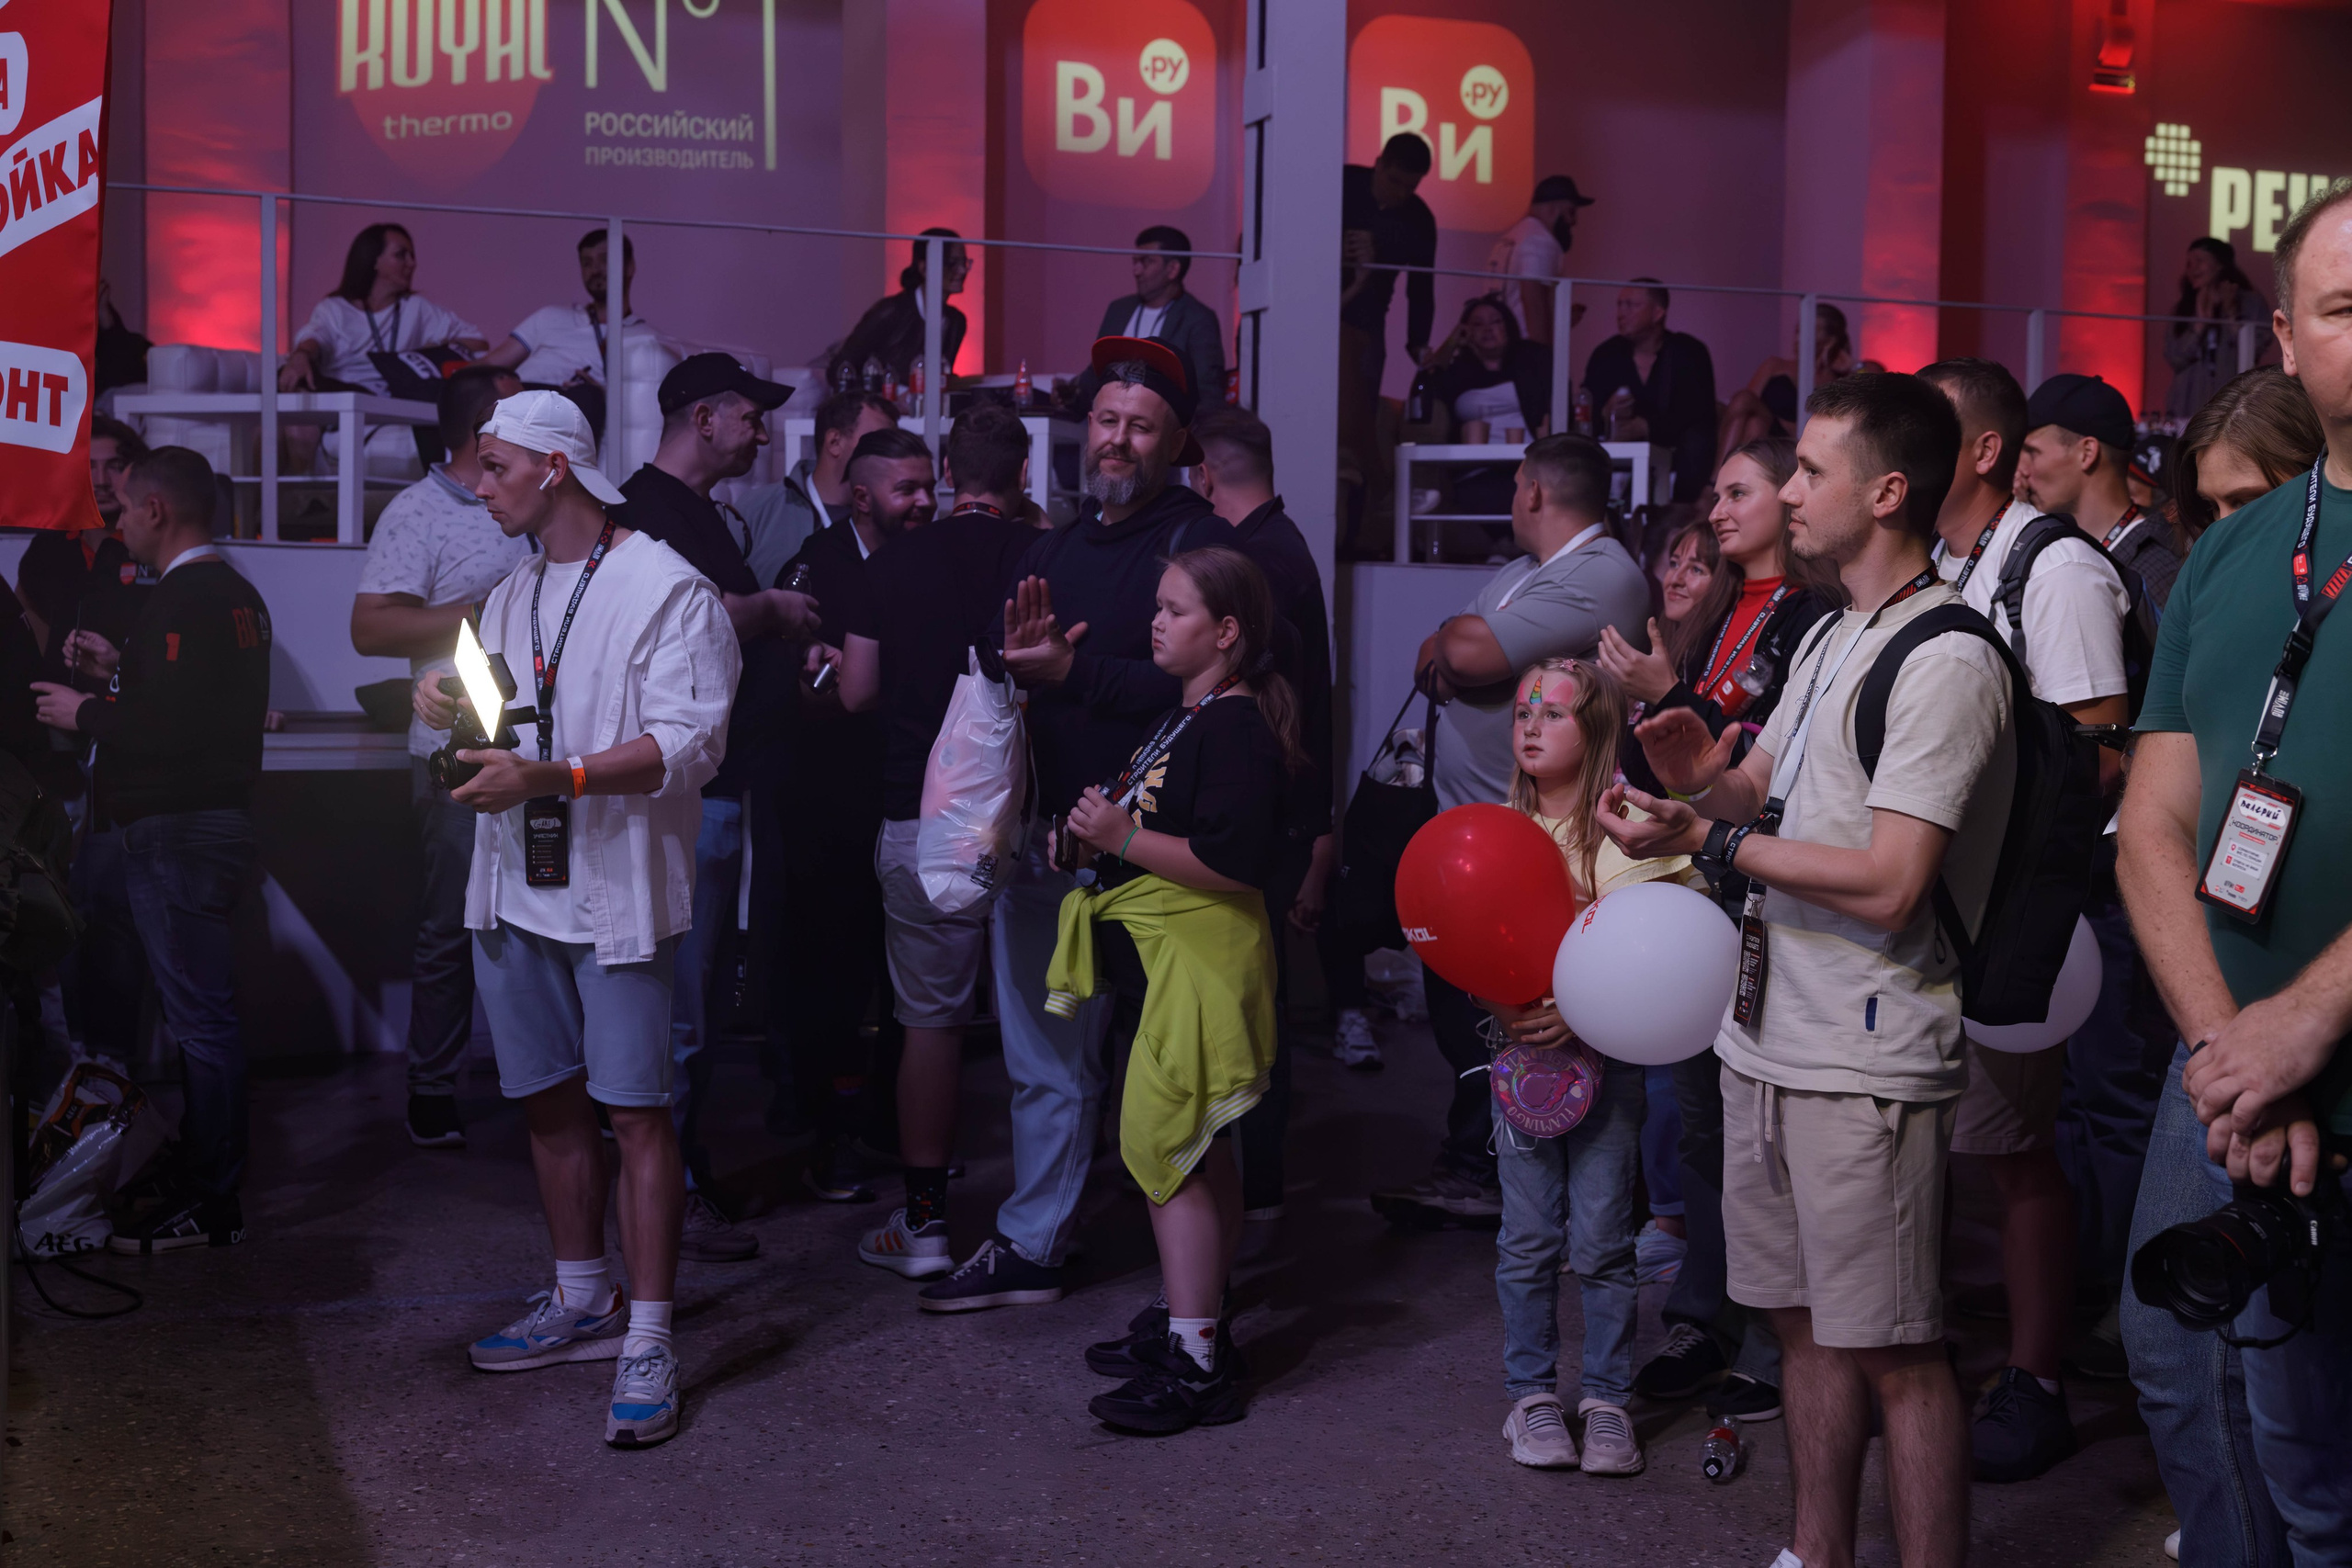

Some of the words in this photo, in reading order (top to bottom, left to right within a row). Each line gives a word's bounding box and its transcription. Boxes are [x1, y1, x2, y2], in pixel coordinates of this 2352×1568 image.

[381, 110, 513, 141] thermo
[585, 110, 755, 142] РОССИЙСКИЙ
[1057, 60, 1173, 161] Ви
[585, 146, 755, 171] ПРОИЗВОДИТЕЛЬ
[0, 367, 69, 428] НТ
[551, 616, 571, 664] СТРОИТЕЛИ
[567, 572, 590, 615] БУДУЩЕГО
[1736, 611, 1767, 650] БУДУЩЕГО
[1126, 748, 1161, 786] СТРОИТЕЛИ
[1159, 714, 1193, 750] БУДУЩЕГО
[1507, 1105, 1577, 1133] FLAMINGO
[33, 1231, 94, 1253] AEG
